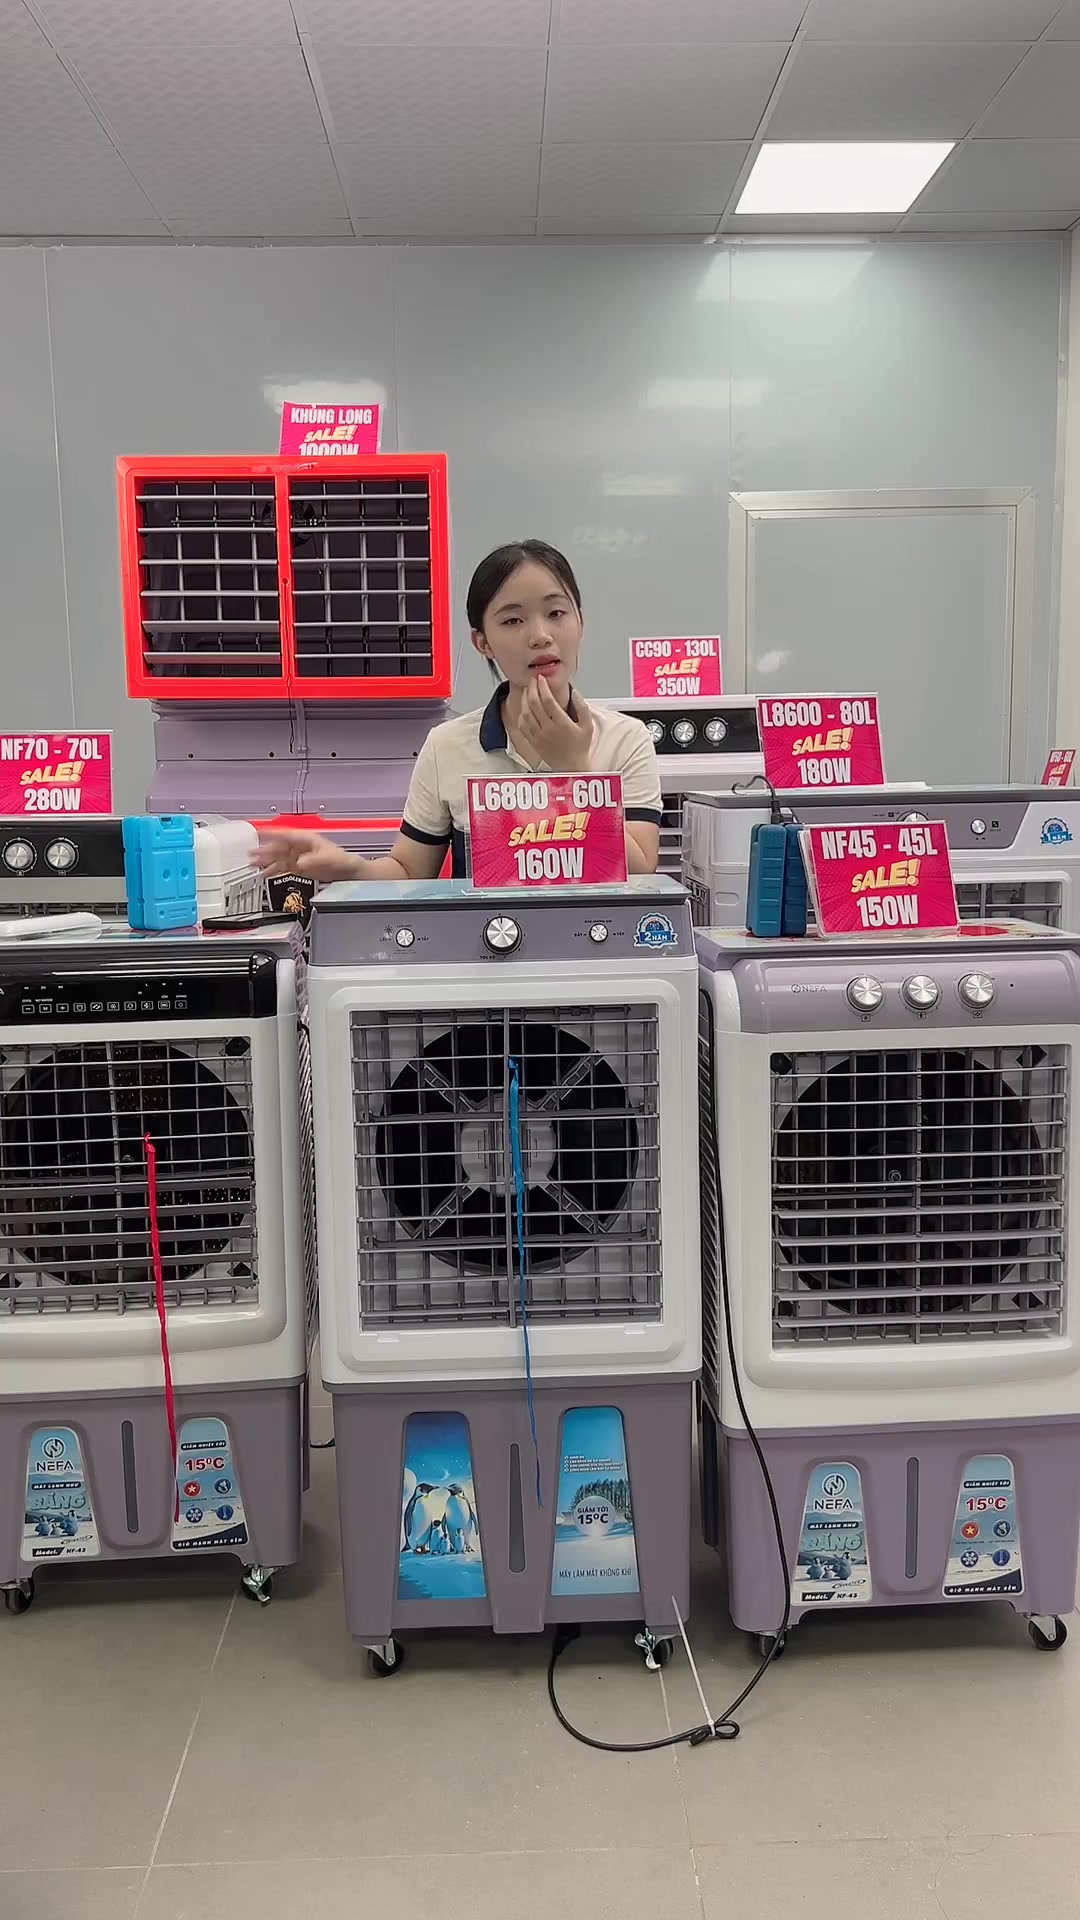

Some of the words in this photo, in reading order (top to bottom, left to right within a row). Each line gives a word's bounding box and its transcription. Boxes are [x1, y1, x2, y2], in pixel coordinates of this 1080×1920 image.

[338, 409, 373, 425] LONG
[304, 425, 358, 442] SALE!
[635, 641, 672, 658] CC90
[684, 640, 717, 657] 130L
[654, 658, 701, 677] SALE!
[657, 677, 701, 696] 350W
[762, 702, 822, 727] L8600
[840, 701, 876, 725] 80L
[1, 738, 49, 760] NF70
[67, 738, 103, 760] 70L
[792, 727, 854, 756] SALE!
[19, 760, 86, 785] SALE!
[797, 758, 851, 785] 180W
[24, 788, 81, 811] 280W
[472, 781, 549, 811] L6800
[573, 779, 617, 808] 60L
[508, 811, 591, 847] SALE!
[821, 830, 877, 860] NF45
[898, 828, 938, 856] 45L
[514, 848, 584, 880] 160W
[851, 858, 921, 893] SALE!
[857, 895, 919, 927] 150W
[644, 931, 652, 941] 2
[802, 985, 828, 993] NEFA
[36, 1460, 74, 1471] NEFA
[814, 1499, 853, 1510] NEFA
